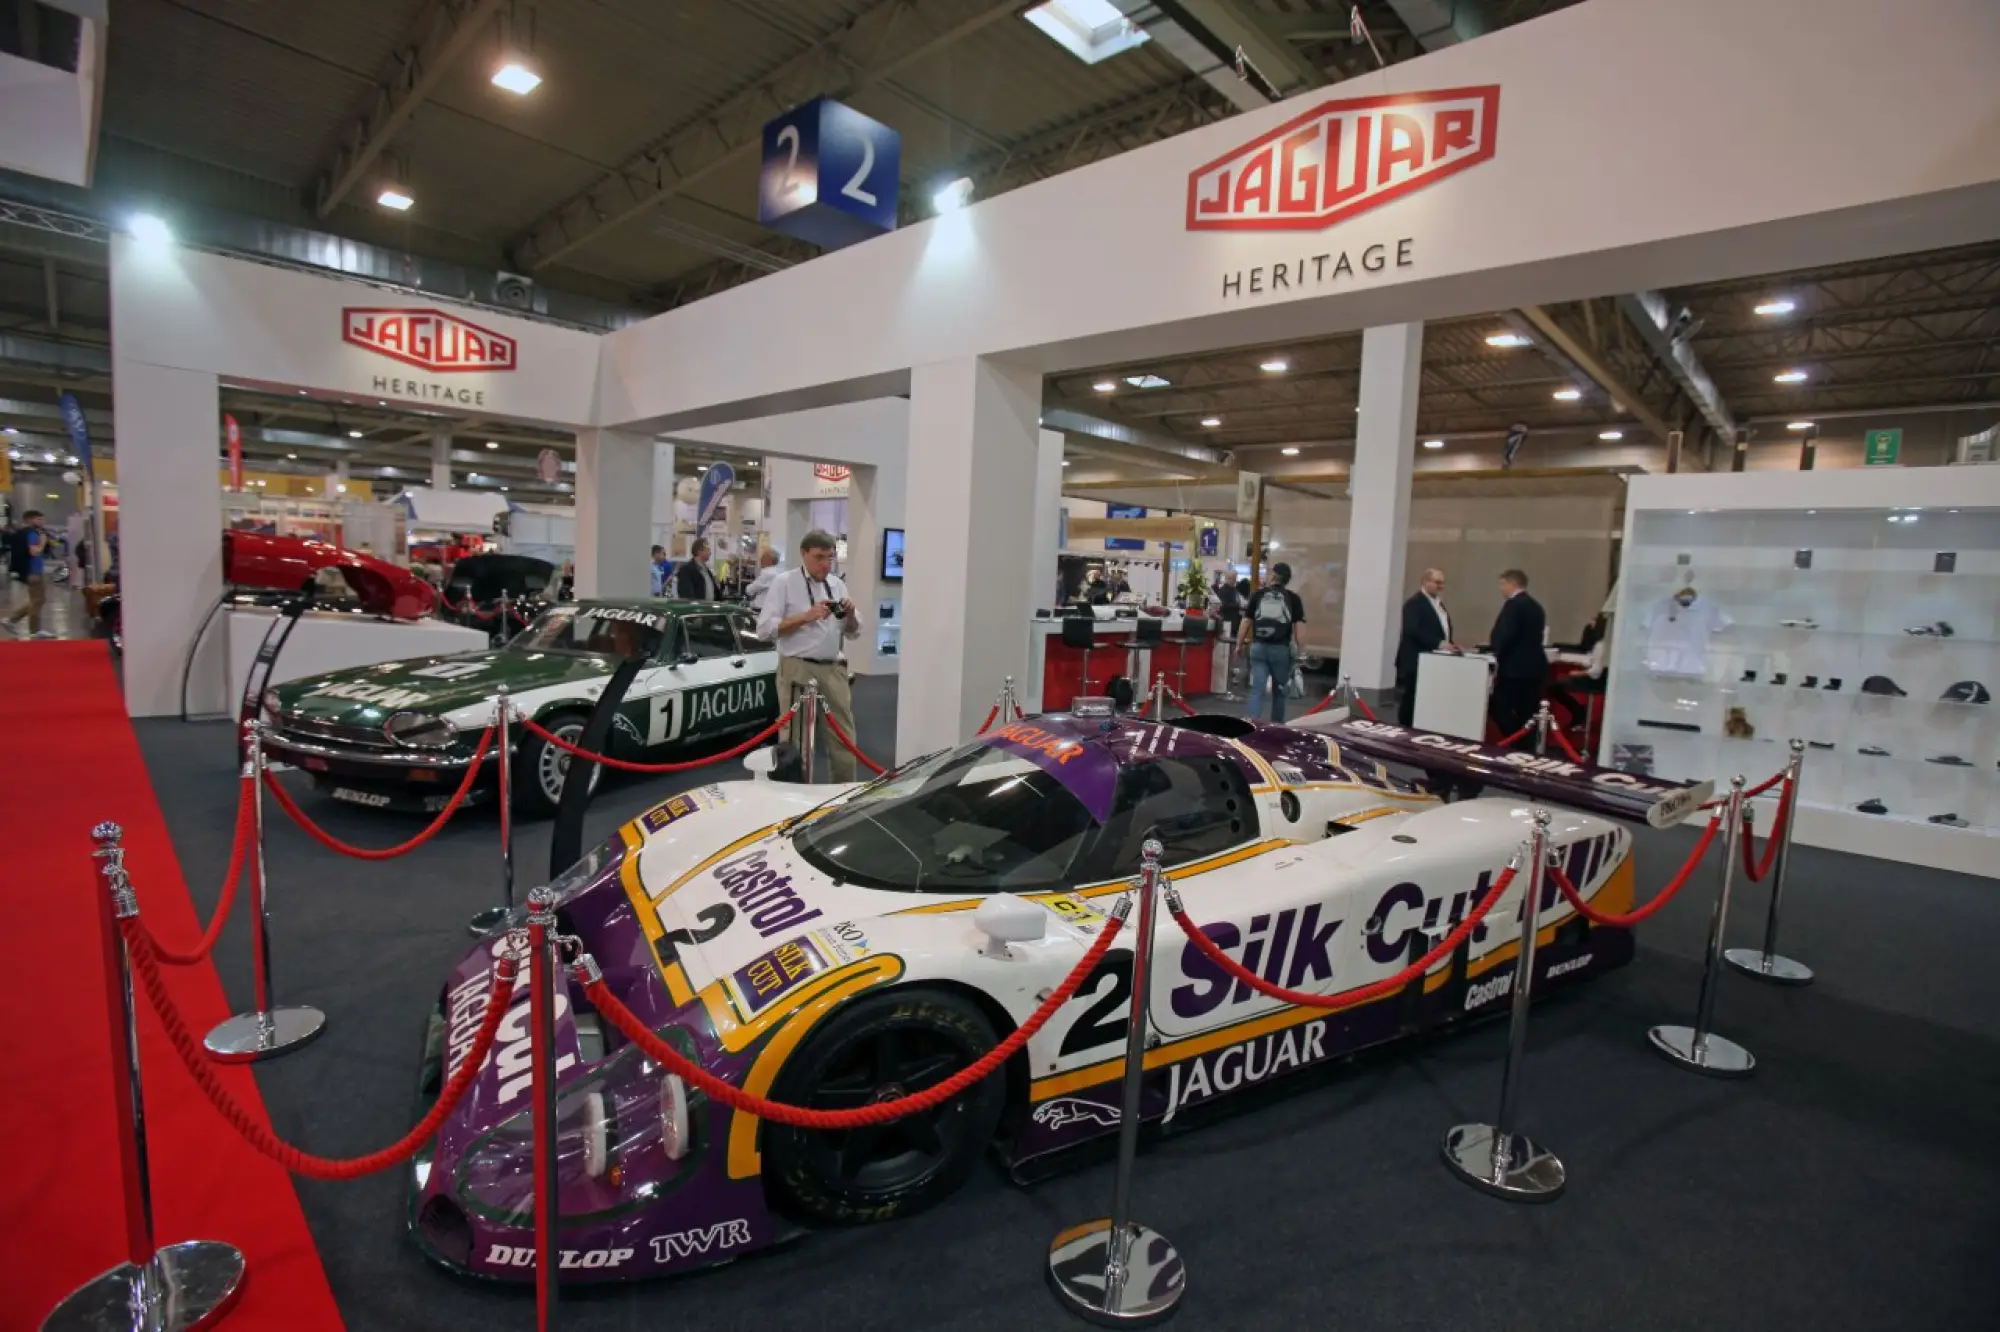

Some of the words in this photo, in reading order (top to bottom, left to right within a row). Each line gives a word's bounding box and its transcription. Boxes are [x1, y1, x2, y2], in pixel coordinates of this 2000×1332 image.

[777, 124, 800, 197] 2
[841, 130, 878, 206] 2
[1199, 108, 1475, 213] JAGUAR
[1222, 237, 1414, 298] HERITAGE
[353, 316, 507, 362] JAGUAR
[372, 374, 485, 405] HERITAGE
[583, 607, 658, 627] JAGUAR
[659, 697, 674, 740] 1
[687, 678, 767, 730] JAGUAR
[1341, 719, 1408, 738] Silk
[1411, 734, 1483, 754] Cut
[1496, 751, 1585, 777] Silk
[331, 787, 392, 808] DUNLOP
[713, 849, 824, 938] Castrol
[654, 902, 736, 968] 2
[773, 942, 810, 981] SILK
[1171, 903, 1344, 1018] Silk
[748, 959, 782, 997] CUT
[1058, 947, 1135, 1057] 2
[1160, 1020, 1327, 1124] JAGUAR
[650, 1218, 752, 1263] TWR
